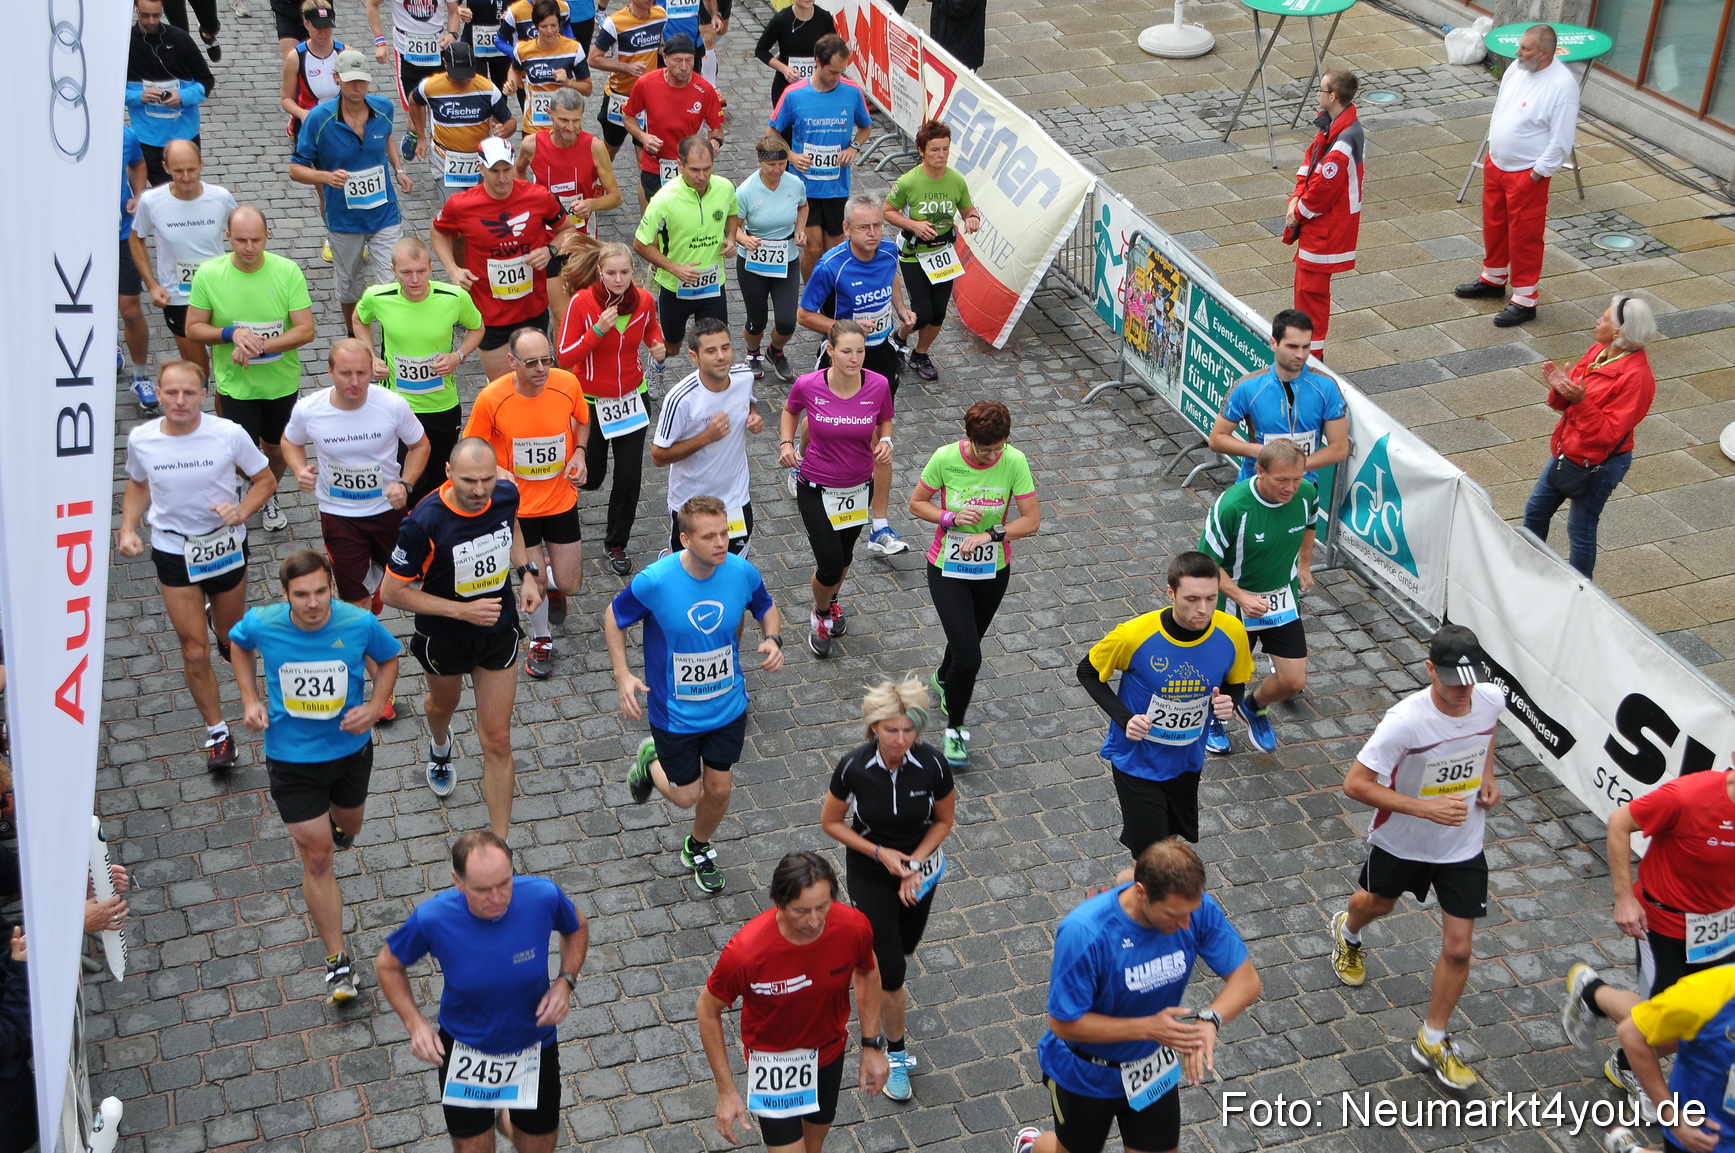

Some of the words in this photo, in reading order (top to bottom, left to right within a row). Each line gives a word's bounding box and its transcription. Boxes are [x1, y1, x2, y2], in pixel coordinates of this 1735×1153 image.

[408, 41, 437, 54] 2610
[446, 105, 482, 117] Fischer
[449, 160, 480, 174] 2772
[348, 177, 381, 196] 3361
[924, 192, 948, 200] FÜRTH
[917, 200, 954, 215] 2012
[166, 219, 216, 229] www.hasit.de
[688, 240, 719, 250] Apotheke
[751, 247, 785, 264] 3373
[924, 251, 952, 271] 180
[498, 266, 526, 285] 204
[507, 286, 520, 294] Eric
[854, 285, 893, 306] SYSCAD
[54, 250, 95, 458] BKK
[1190, 338, 1220, 376] Mehr
[1187, 363, 1205, 393] für
[602, 397, 639, 422] 3347
[1185, 399, 1202, 424] Miet
[323, 432, 382, 445] www.hasit.de
[525, 446, 557, 465] 158
[153, 460, 214, 471] www.hasit.de
[530, 467, 551, 475] Alfred
[333, 472, 379, 490] 2563
[341, 491, 371, 501] Stephan
[836, 495, 855, 512] 76
[838, 514, 853, 523] Nora
[191, 536, 237, 564] 2564
[200, 557, 234, 574] Wolfgang
[455, 556, 475, 566] PARTL
[474, 555, 497, 578] 88
[957, 564, 984, 574] Claudia
[1342, 531, 1371, 558] Gebäude
[1372, 553, 1397, 577] Service
[1397, 570, 1420, 594] GmbH
[472, 576, 501, 590] Ludwig
[55, 499, 93, 726] Audi
[1259, 616, 1282, 625] Hubert
[697, 653, 725, 663] Neumarkt
[304, 666, 336, 675] Neumarkt
[681, 658, 729, 683] 2844
[294, 676, 336, 697] 234
[690, 682, 723, 695] Manfred
[301, 702, 330, 711] Tobias
[1152, 700, 1172, 711] PARTL
[1493, 676, 1511, 697] die
[1510, 691, 1560, 748] verbinden
[1151, 709, 1204, 729] 2362
[1160, 732, 1186, 740] Julian
[1435, 760, 1475, 784] 305
[1438, 783, 1467, 794] Harald
[1124, 949, 1187, 984] HUBER
[456, 1056, 518, 1084] 2457
[755, 1064, 812, 1091] 2026
[463, 1087, 501, 1100] Richard
[1146, 1078, 1172, 1101] Günter
[762, 1095, 804, 1110] Wolfgang
